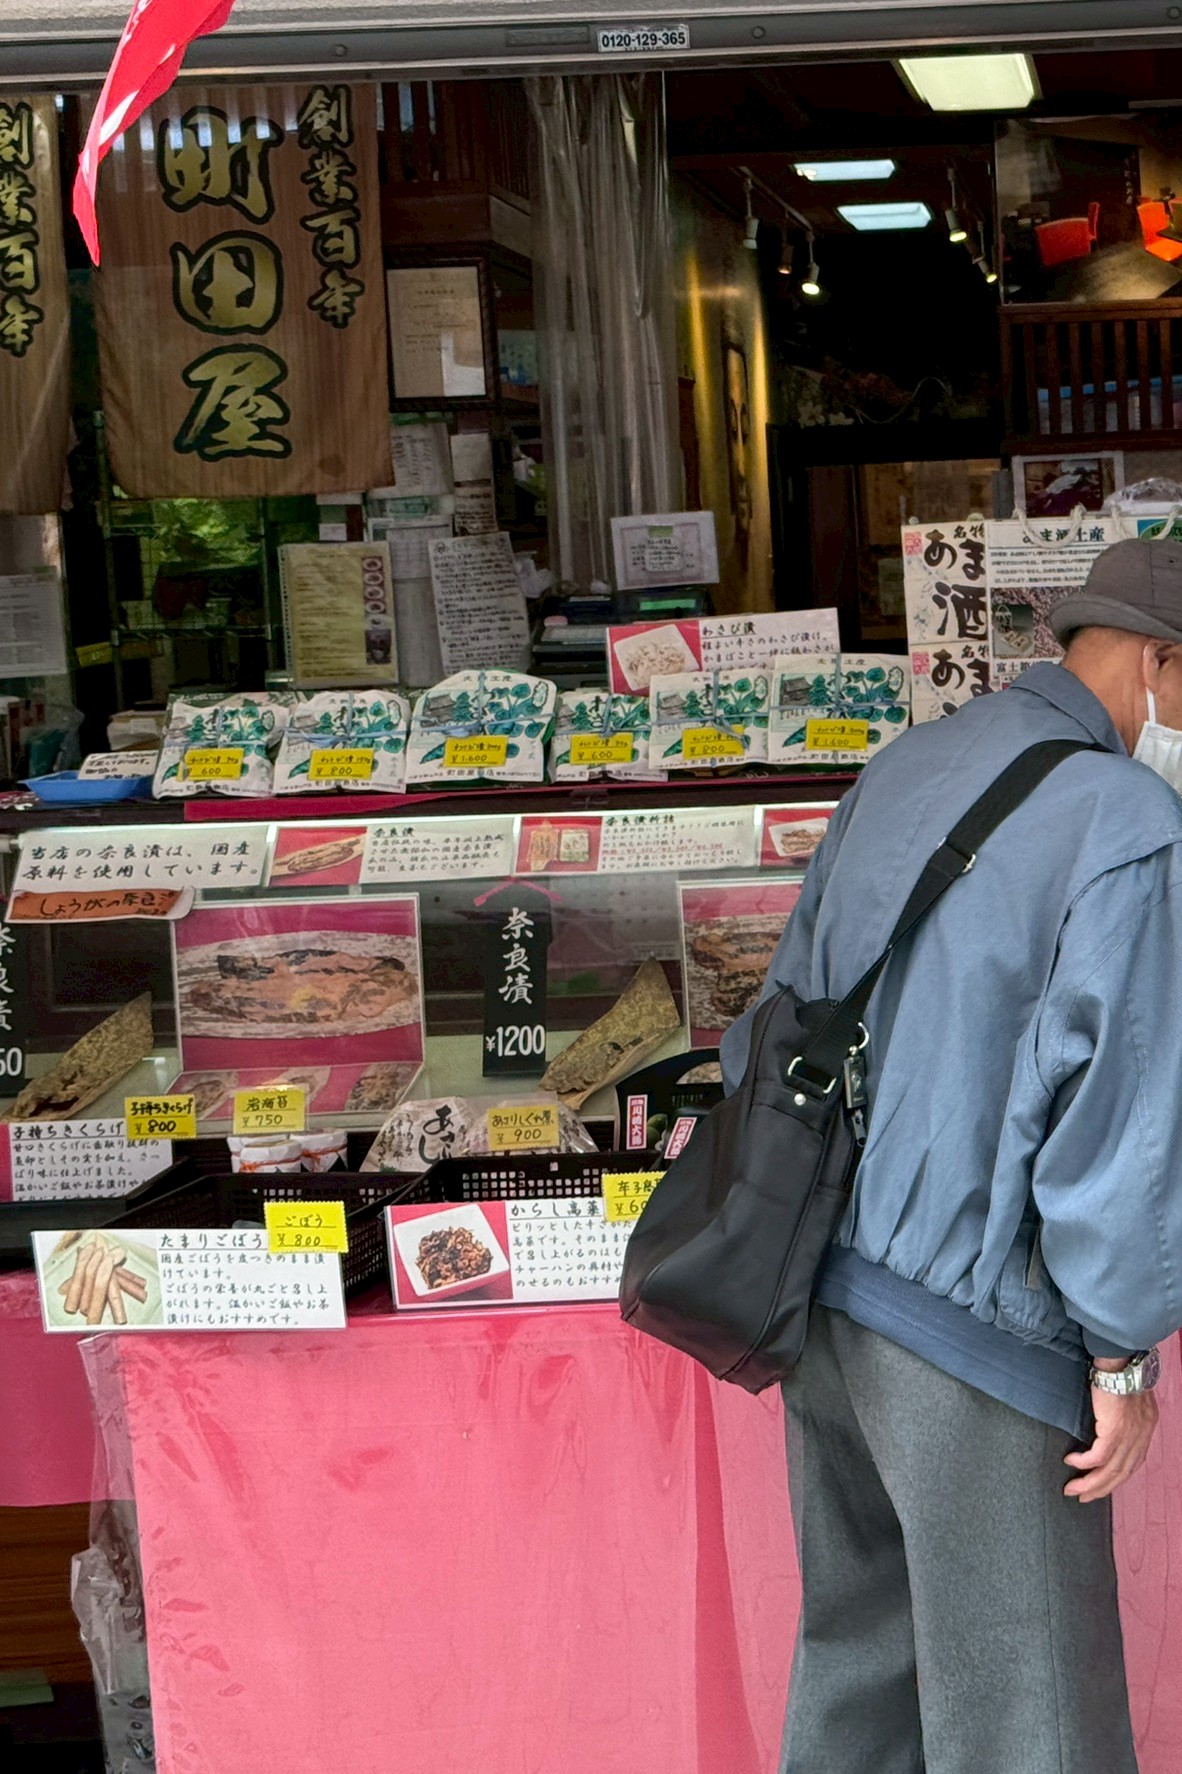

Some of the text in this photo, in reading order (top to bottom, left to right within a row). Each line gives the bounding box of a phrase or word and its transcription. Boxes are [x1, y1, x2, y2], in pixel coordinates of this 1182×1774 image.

[601, 32, 686, 48] 0120-129-365
[157, 107, 291, 462] 町田屋
[703, 621, 755, 636] わさび漬
[22, 862, 259, 882] 原料を使用しています。
[498, 907, 535, 1005] 奈良漬
[485, 1024, 546, 1057] ¥1200
[13, 1121, 124, 1139] 子持ちきくらげ
[512, 1201, 601, 1217] からし高菜
[285, 1214, 323, 1227] ごぼう
[161, 1232, 263, 1249] たまりごぼう
[163, 1267, 232, 1281] けています。
[166, 1297, 330, 1310] がれます。温かいご飯やお茶
[168, 1312, 300, 1326] 漬けにもおすすめです。
